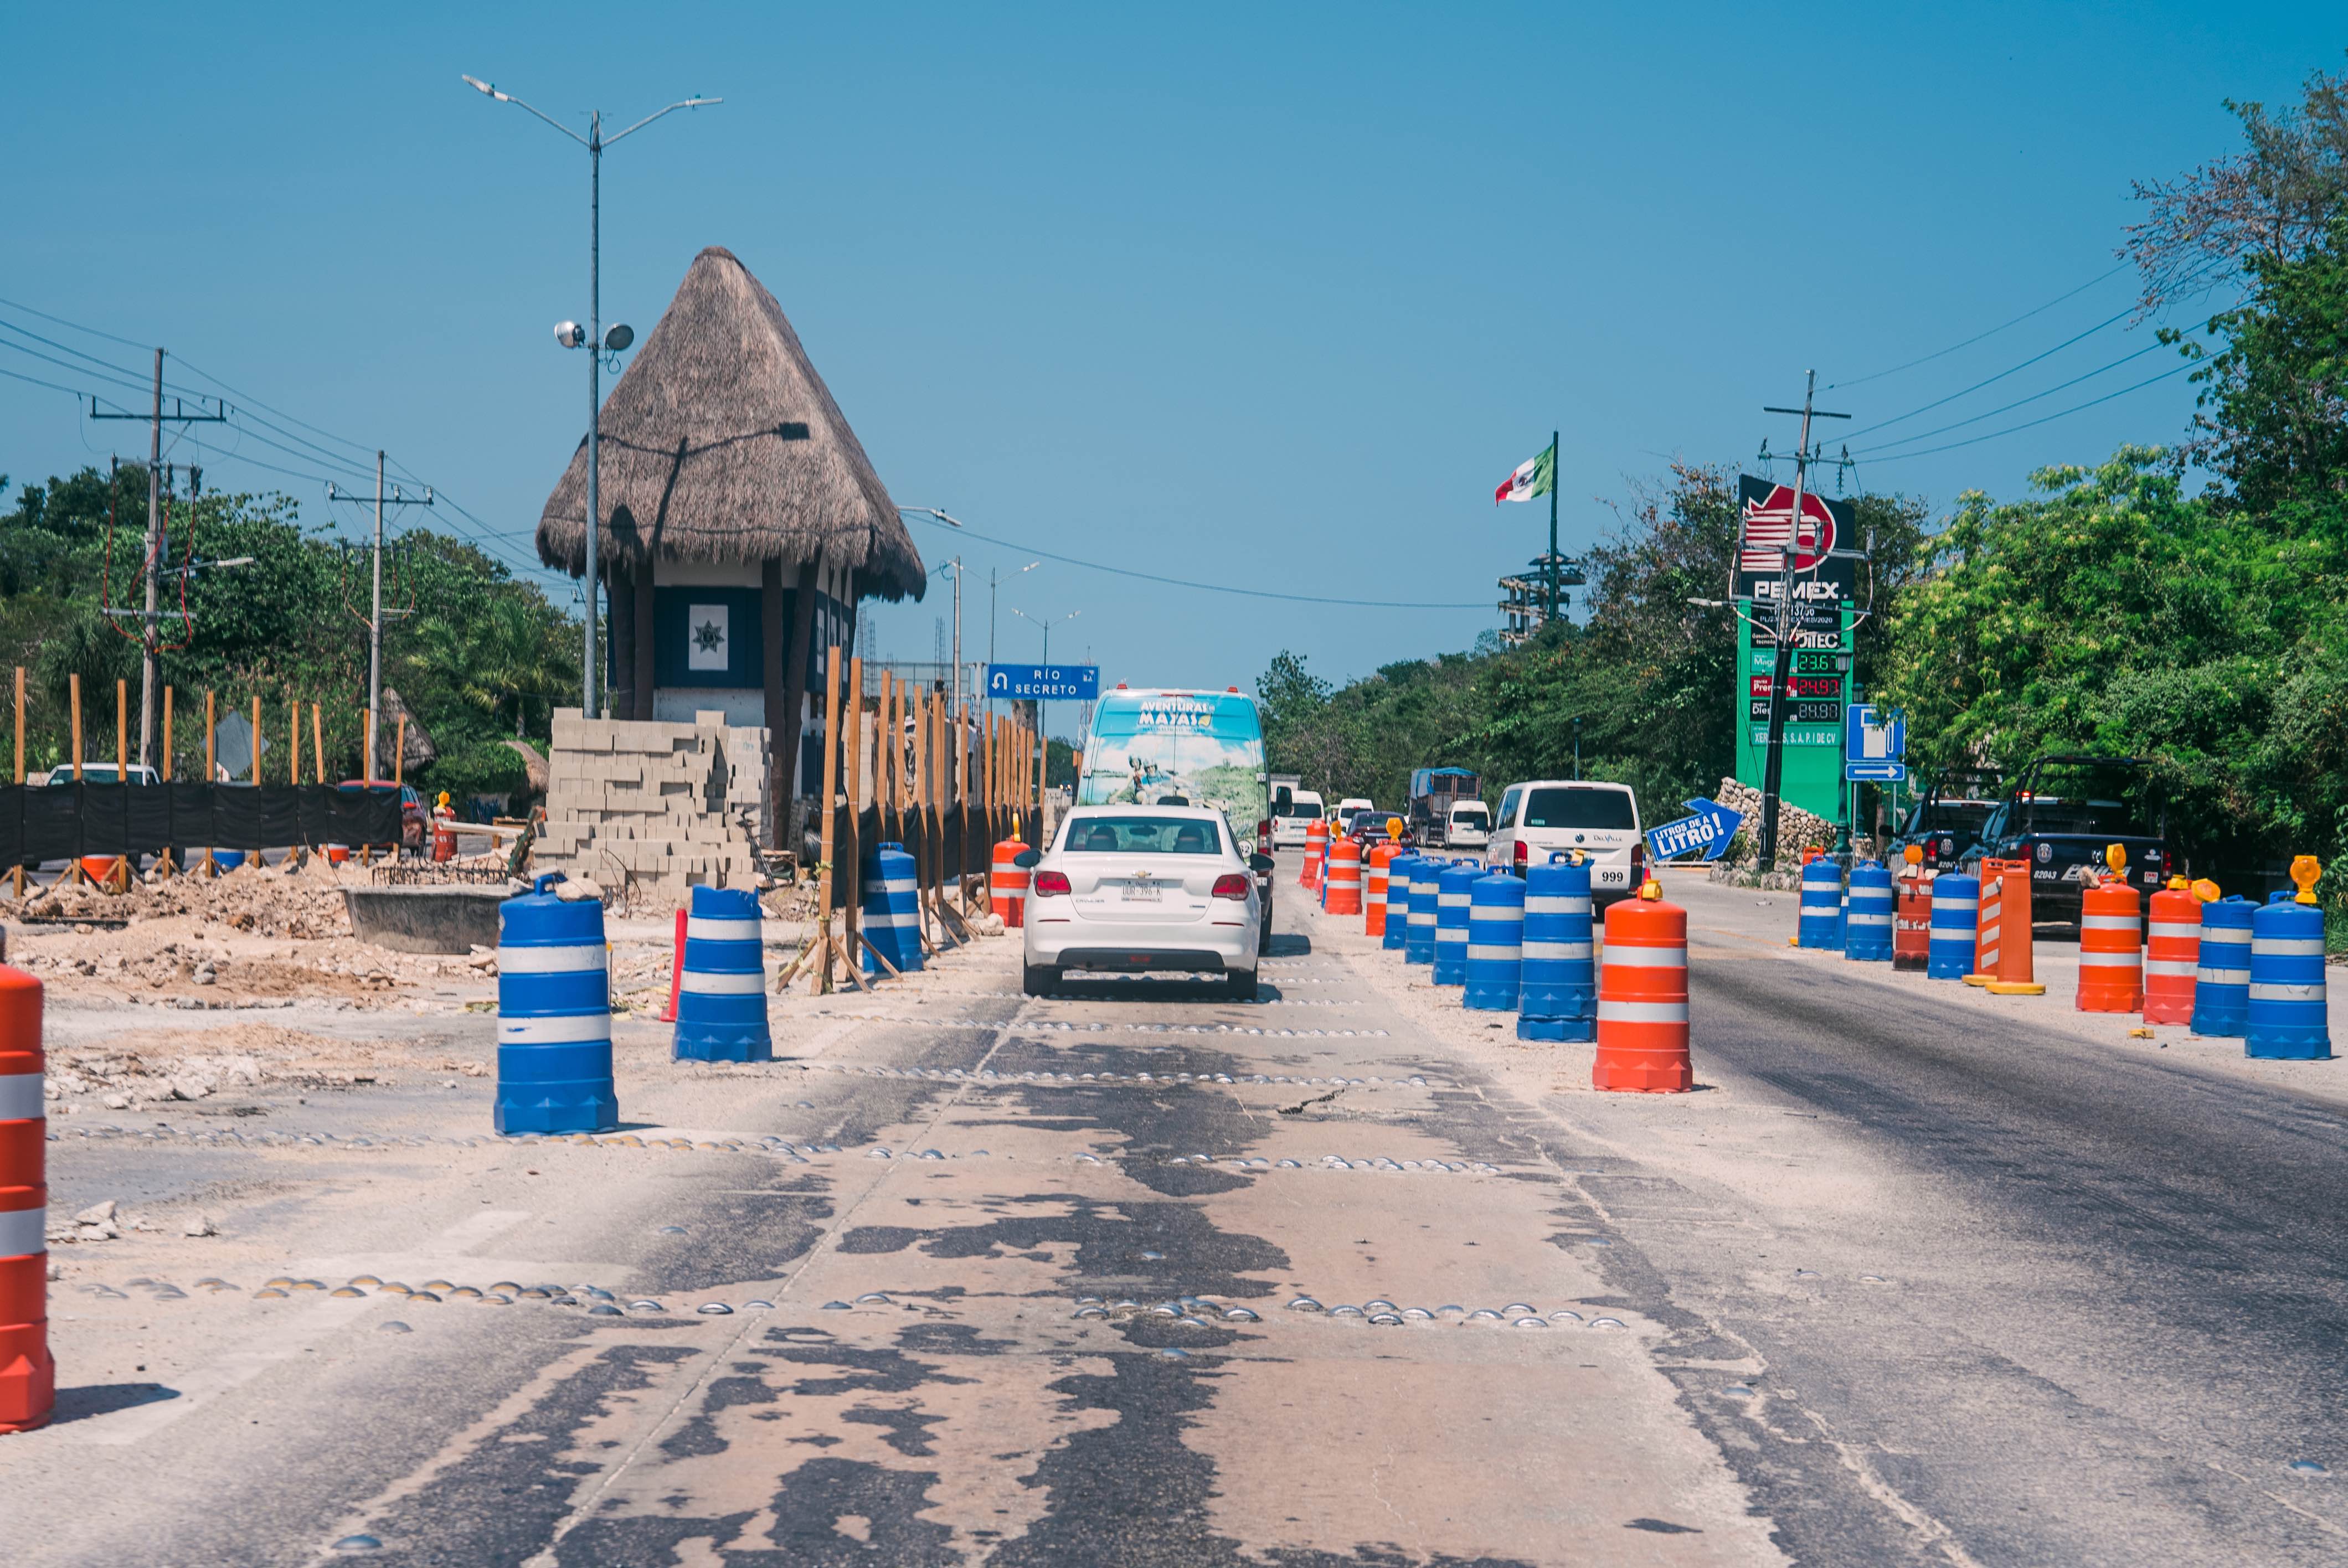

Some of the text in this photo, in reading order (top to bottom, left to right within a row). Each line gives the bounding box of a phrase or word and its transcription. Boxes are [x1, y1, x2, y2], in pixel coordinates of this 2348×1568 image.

[1754, 581, 1839, 599] PEMEX
[1799, 655, 1838, 670] 23.67
[1034, 668, 1060, 680] RÍO
[1015, 684, 1077, 695] SECRETO
[1140, 700, 1208, 713] AVENTURAS
[1138, 711, 1198, 726] MAYAS
[1816, 734, 1825, 744] DE
[1654, 815, 1710, 840] LITROS DE A
[1657, 812, 1724, 856] LITRO!
[1602, 871, 1624, 883] 999
